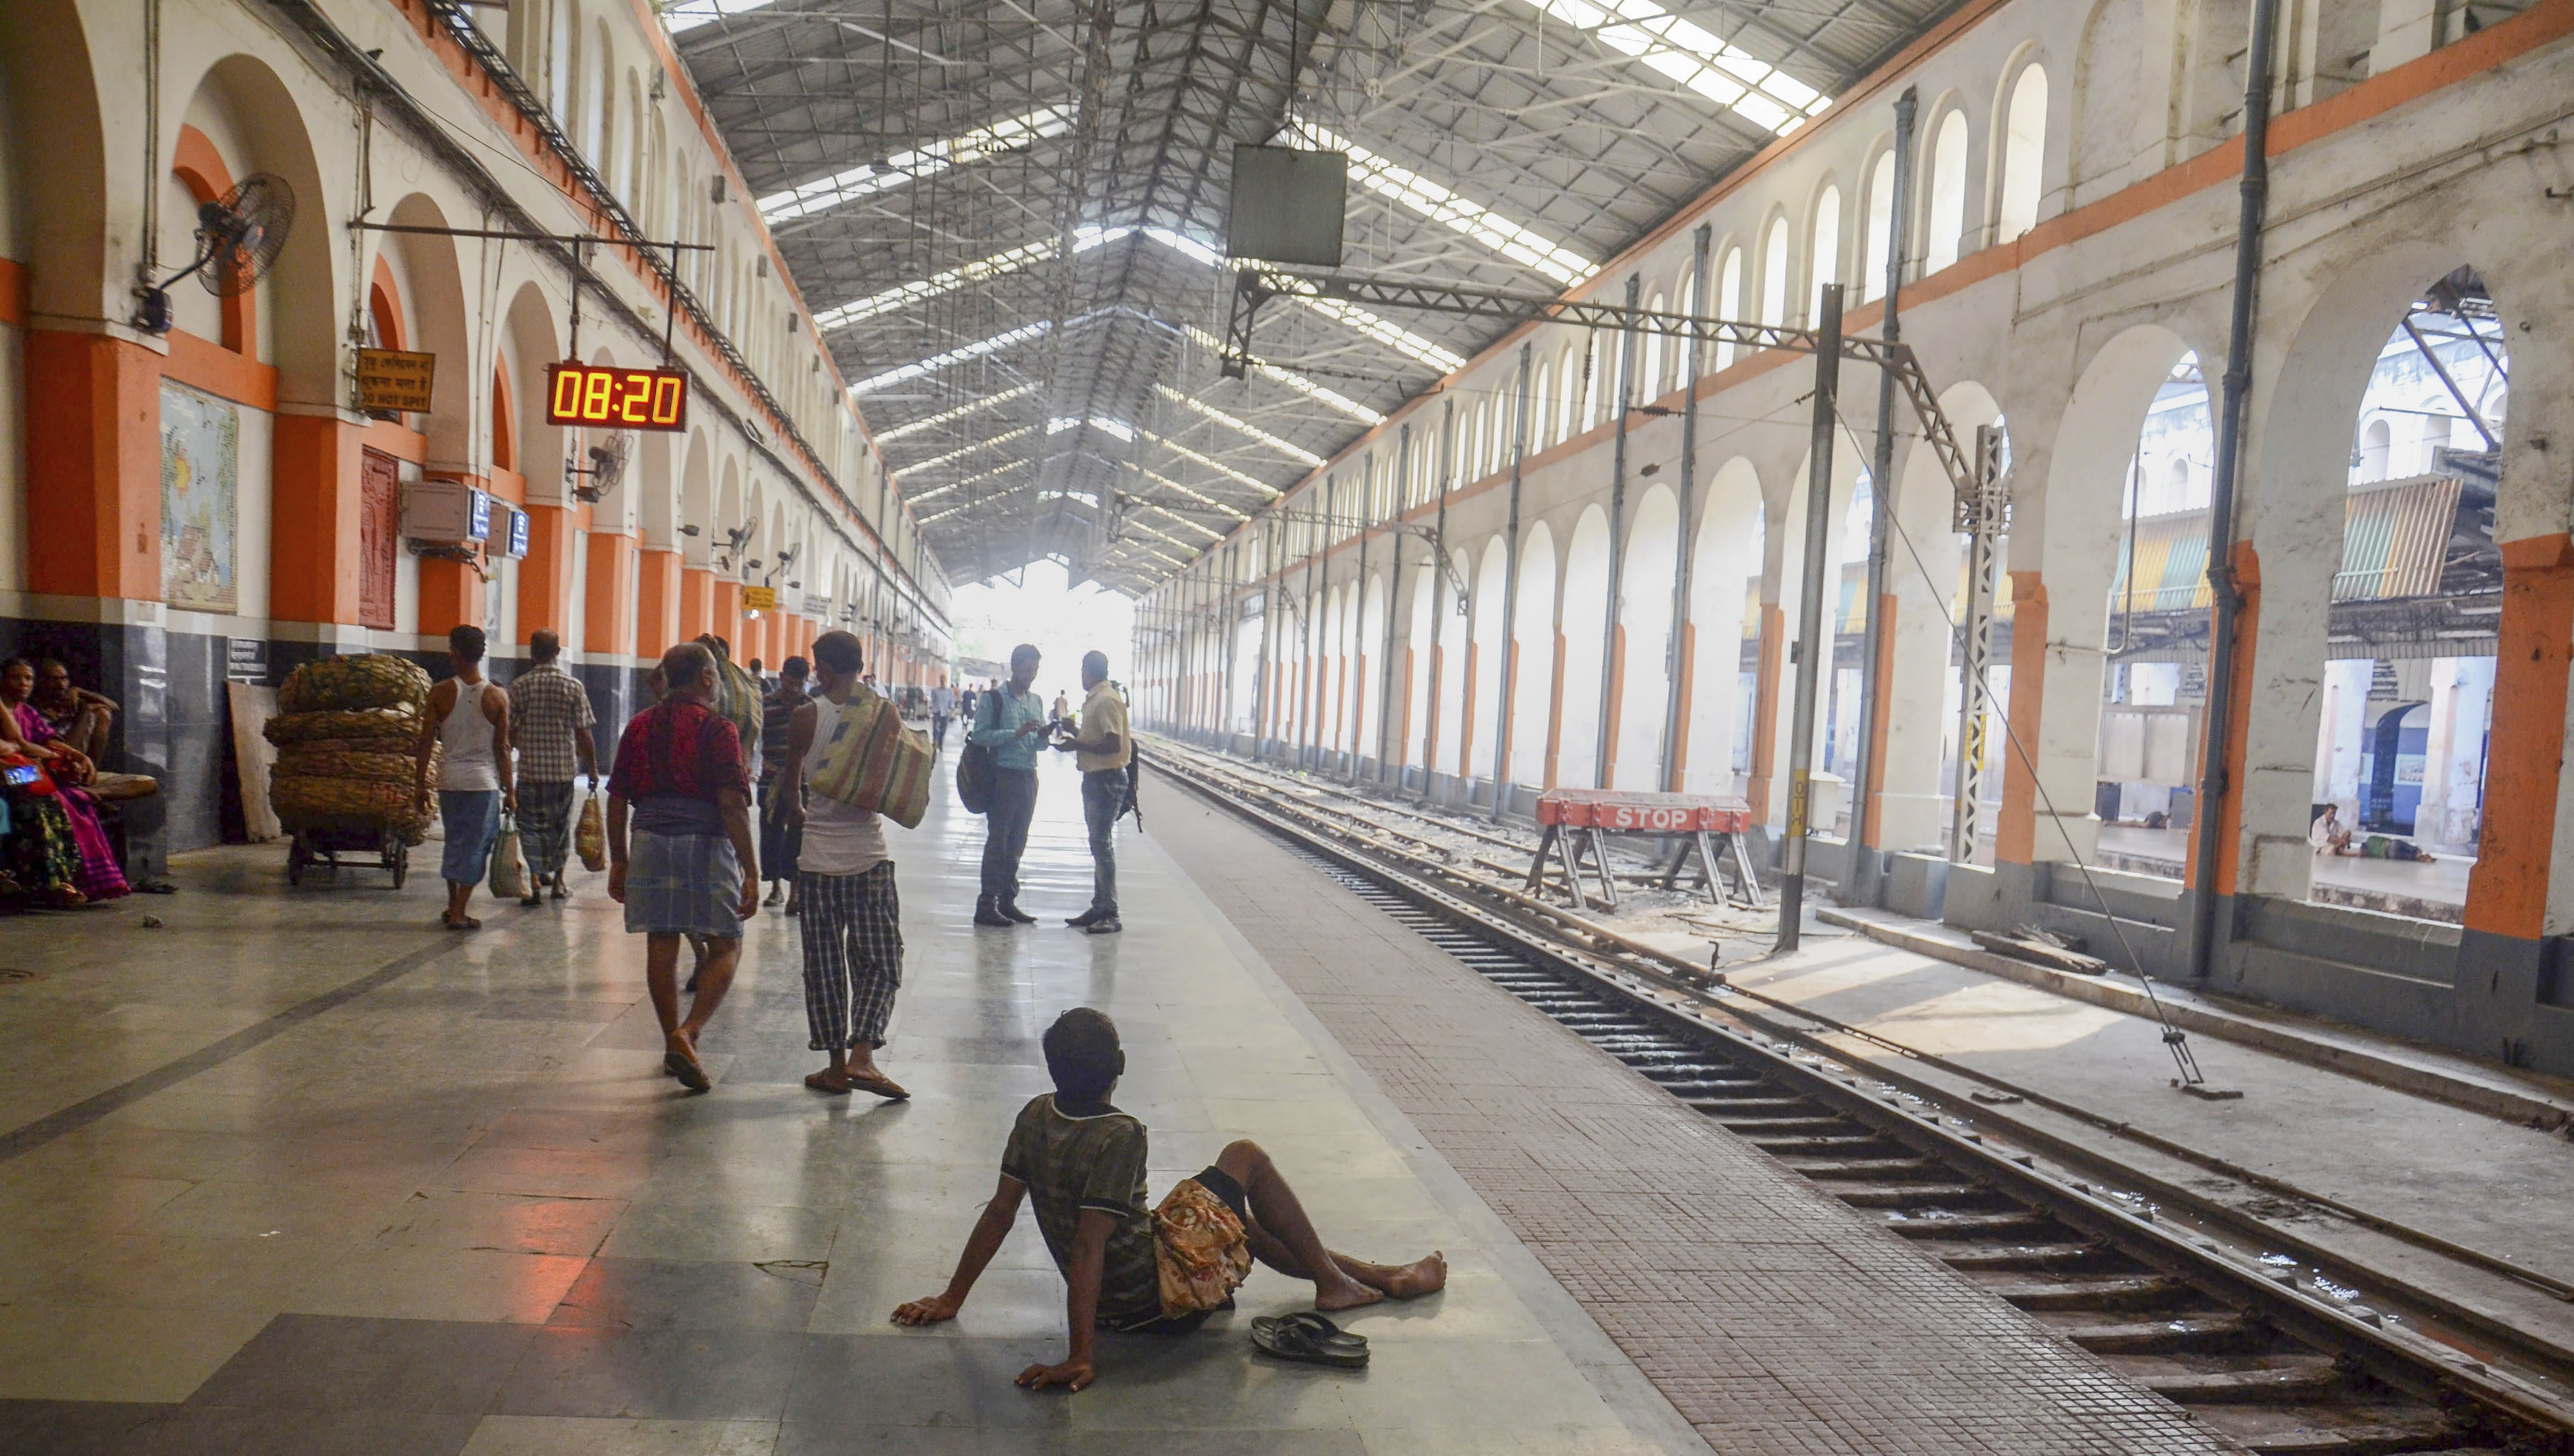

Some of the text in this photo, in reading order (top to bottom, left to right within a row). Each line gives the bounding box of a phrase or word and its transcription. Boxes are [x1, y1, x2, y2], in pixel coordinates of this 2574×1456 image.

[378, 395, 399, 405] NOT
[403, 396, 426, 408] SPIT
[554, 370, 681, 424] 08:20
[1616, 807, 1687, 828] STOP
